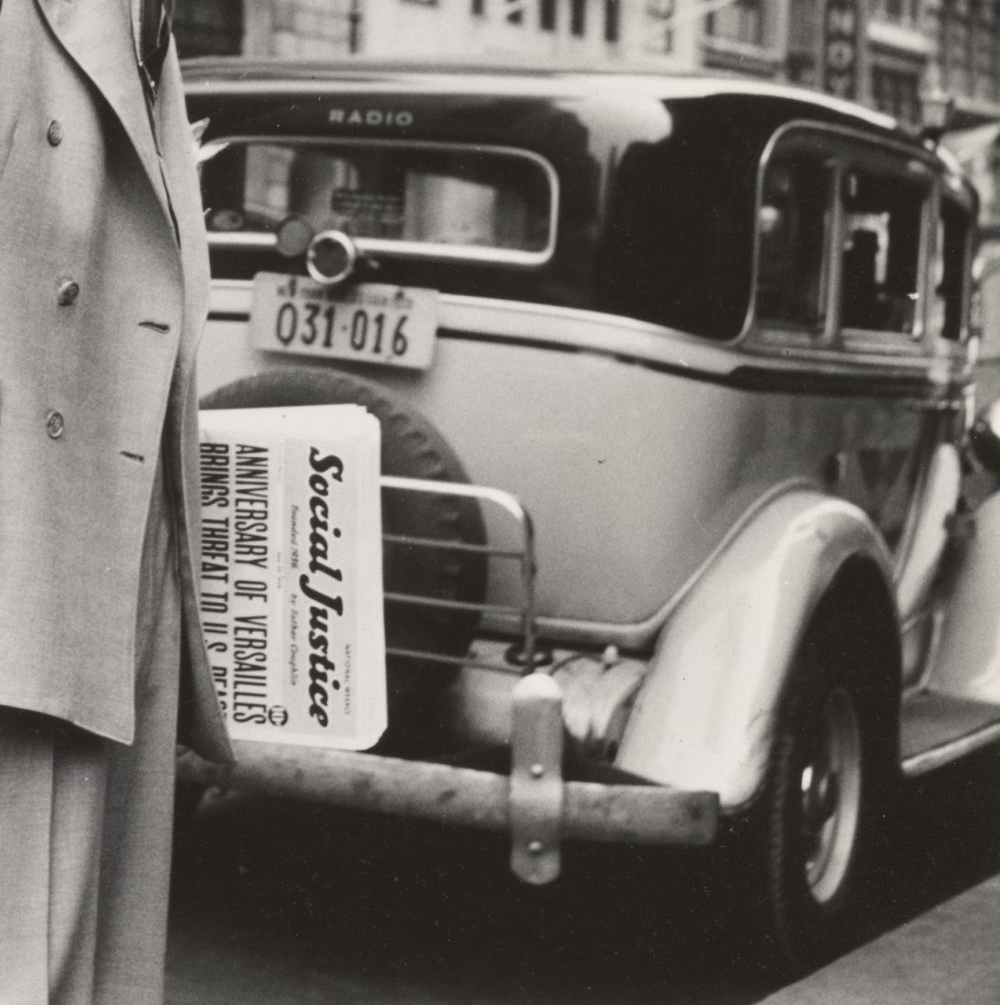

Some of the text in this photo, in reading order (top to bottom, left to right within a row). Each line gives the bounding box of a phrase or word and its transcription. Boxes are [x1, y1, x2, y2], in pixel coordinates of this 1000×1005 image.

[328, 108, 414, 127] RADIO
[199, 442, 230, 508] BRINGS
[290, 504, 300, 546] Founded
[200, 517, 230, 584] THREAT
[200, 591, 229, 614] TO
[232, 443, 269, 725] ANNIVERSARY OF VERSAILLES
[299, 445, 344, 728] Social Justice
[290, 609, 299, 643] Father
[288, 644, 299, 687] Coughlin
